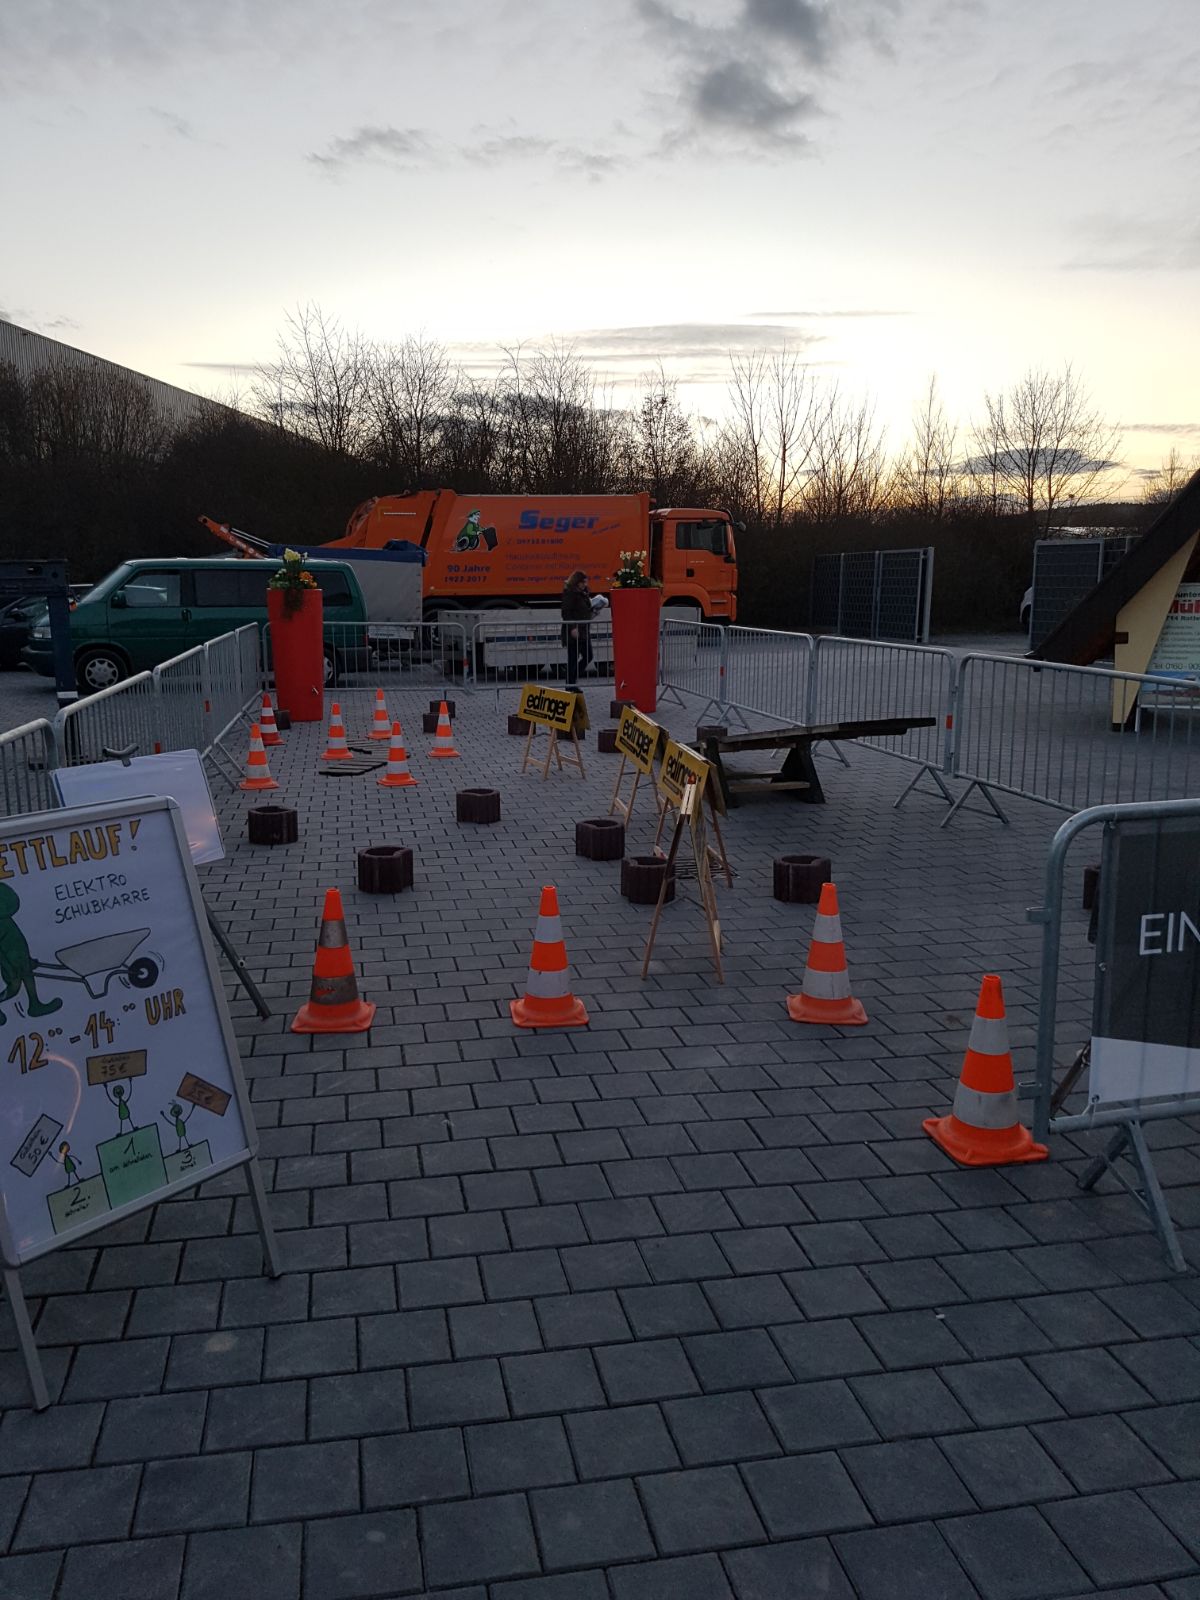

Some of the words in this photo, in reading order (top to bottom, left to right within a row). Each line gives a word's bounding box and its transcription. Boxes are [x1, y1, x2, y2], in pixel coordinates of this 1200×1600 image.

[518, 510, 600, 533] Seger
[447, 564, 460, 573] 90
[463, 564, 491, 573] Jahre
[526, 689, 570, 721] edinger
[622, 715, 654, 758] edinger
[54, 873, 128, 901] ELEKTRO
[54, 887, 151, 924] SCHUBKARRE
[144, 988, 187, 1025] UHR
[70, 1186, 91, 1207] 2.
